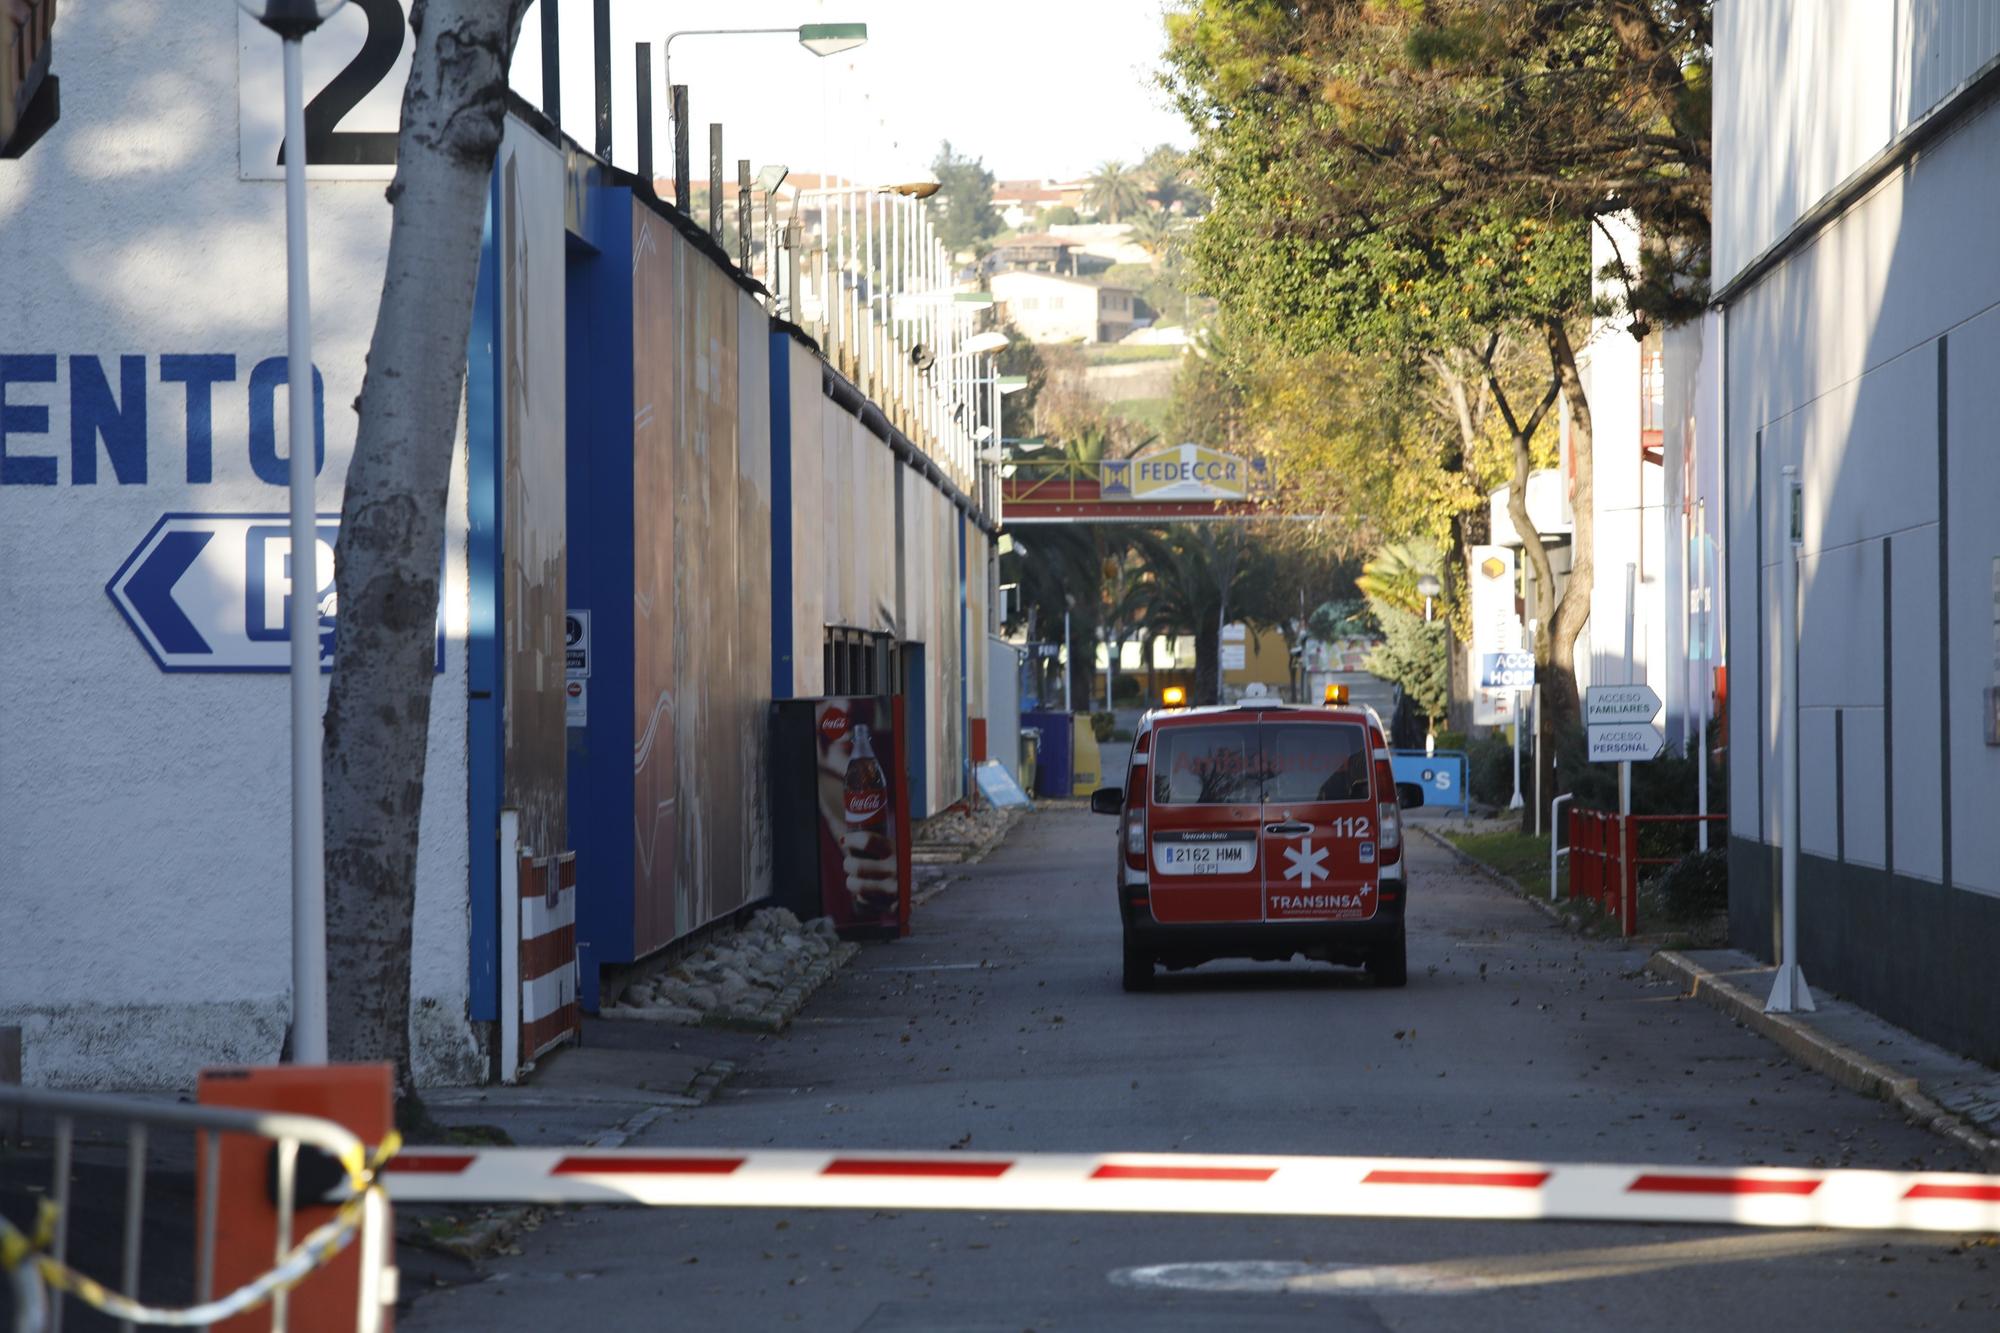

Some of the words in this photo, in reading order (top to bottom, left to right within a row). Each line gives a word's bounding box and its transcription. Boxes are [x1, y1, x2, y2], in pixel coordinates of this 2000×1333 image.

[277, 0, 404, 165] 2
[0, 353, 325, 486] ENTO
[1141, 462, 1237, 481] FEDECOR
[1599, 693, 1640, 703] ACCESO
[1590, 704, 1650, 714] FAMILIARES
[1600, 732, 1641, 742] ACCESO
[1593, 744, 1648, 753] PERSONAL
[1435, 771, 1450, 790] S
[1332, 816, 1370, 838] 112
[1216, 847, 1242, 861] HMM
[1270, 895, 1362, 909] TRANSINSA
